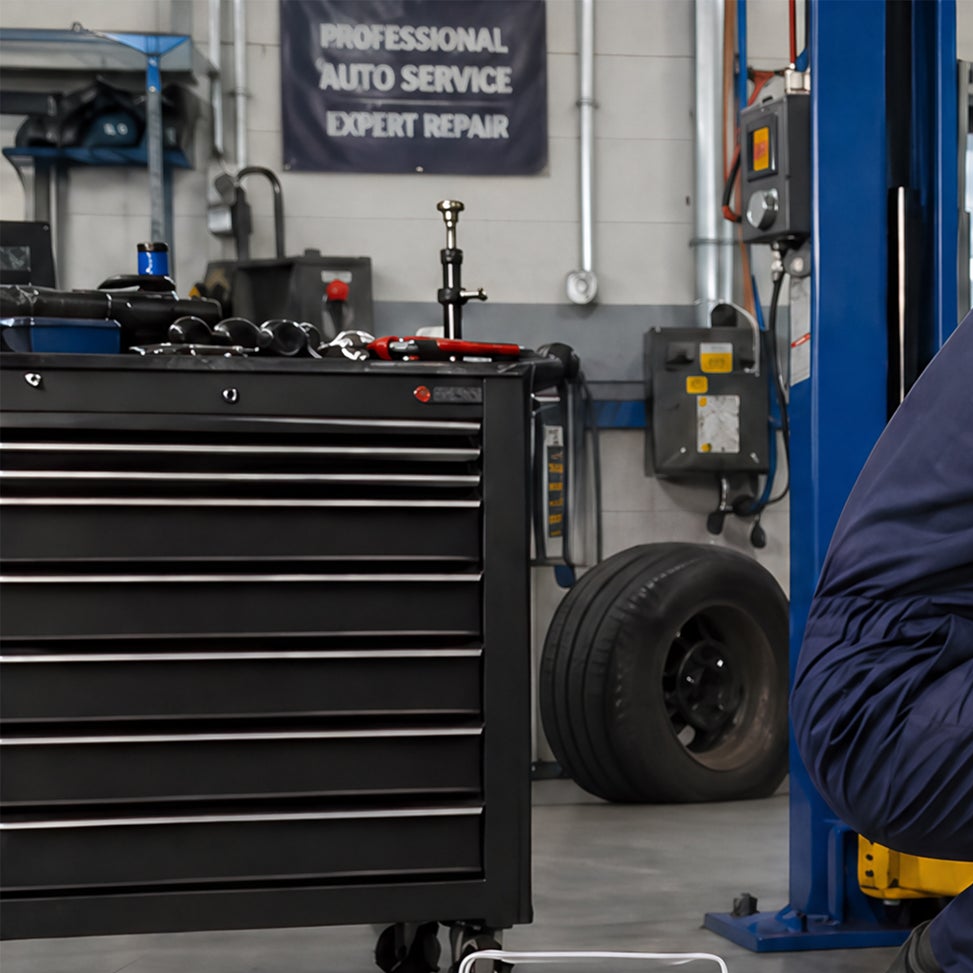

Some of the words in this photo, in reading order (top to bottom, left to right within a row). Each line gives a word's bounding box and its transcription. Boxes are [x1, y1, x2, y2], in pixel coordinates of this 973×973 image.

[319, 23, 509, 54] PROFESSIONAL
[319, 63, 396, 92] AUTO
[401, 65, 513, 94] SERVICE
[326, 111, 419, 138] EXPERT
[424, 113, 509, 139] REPAIR
